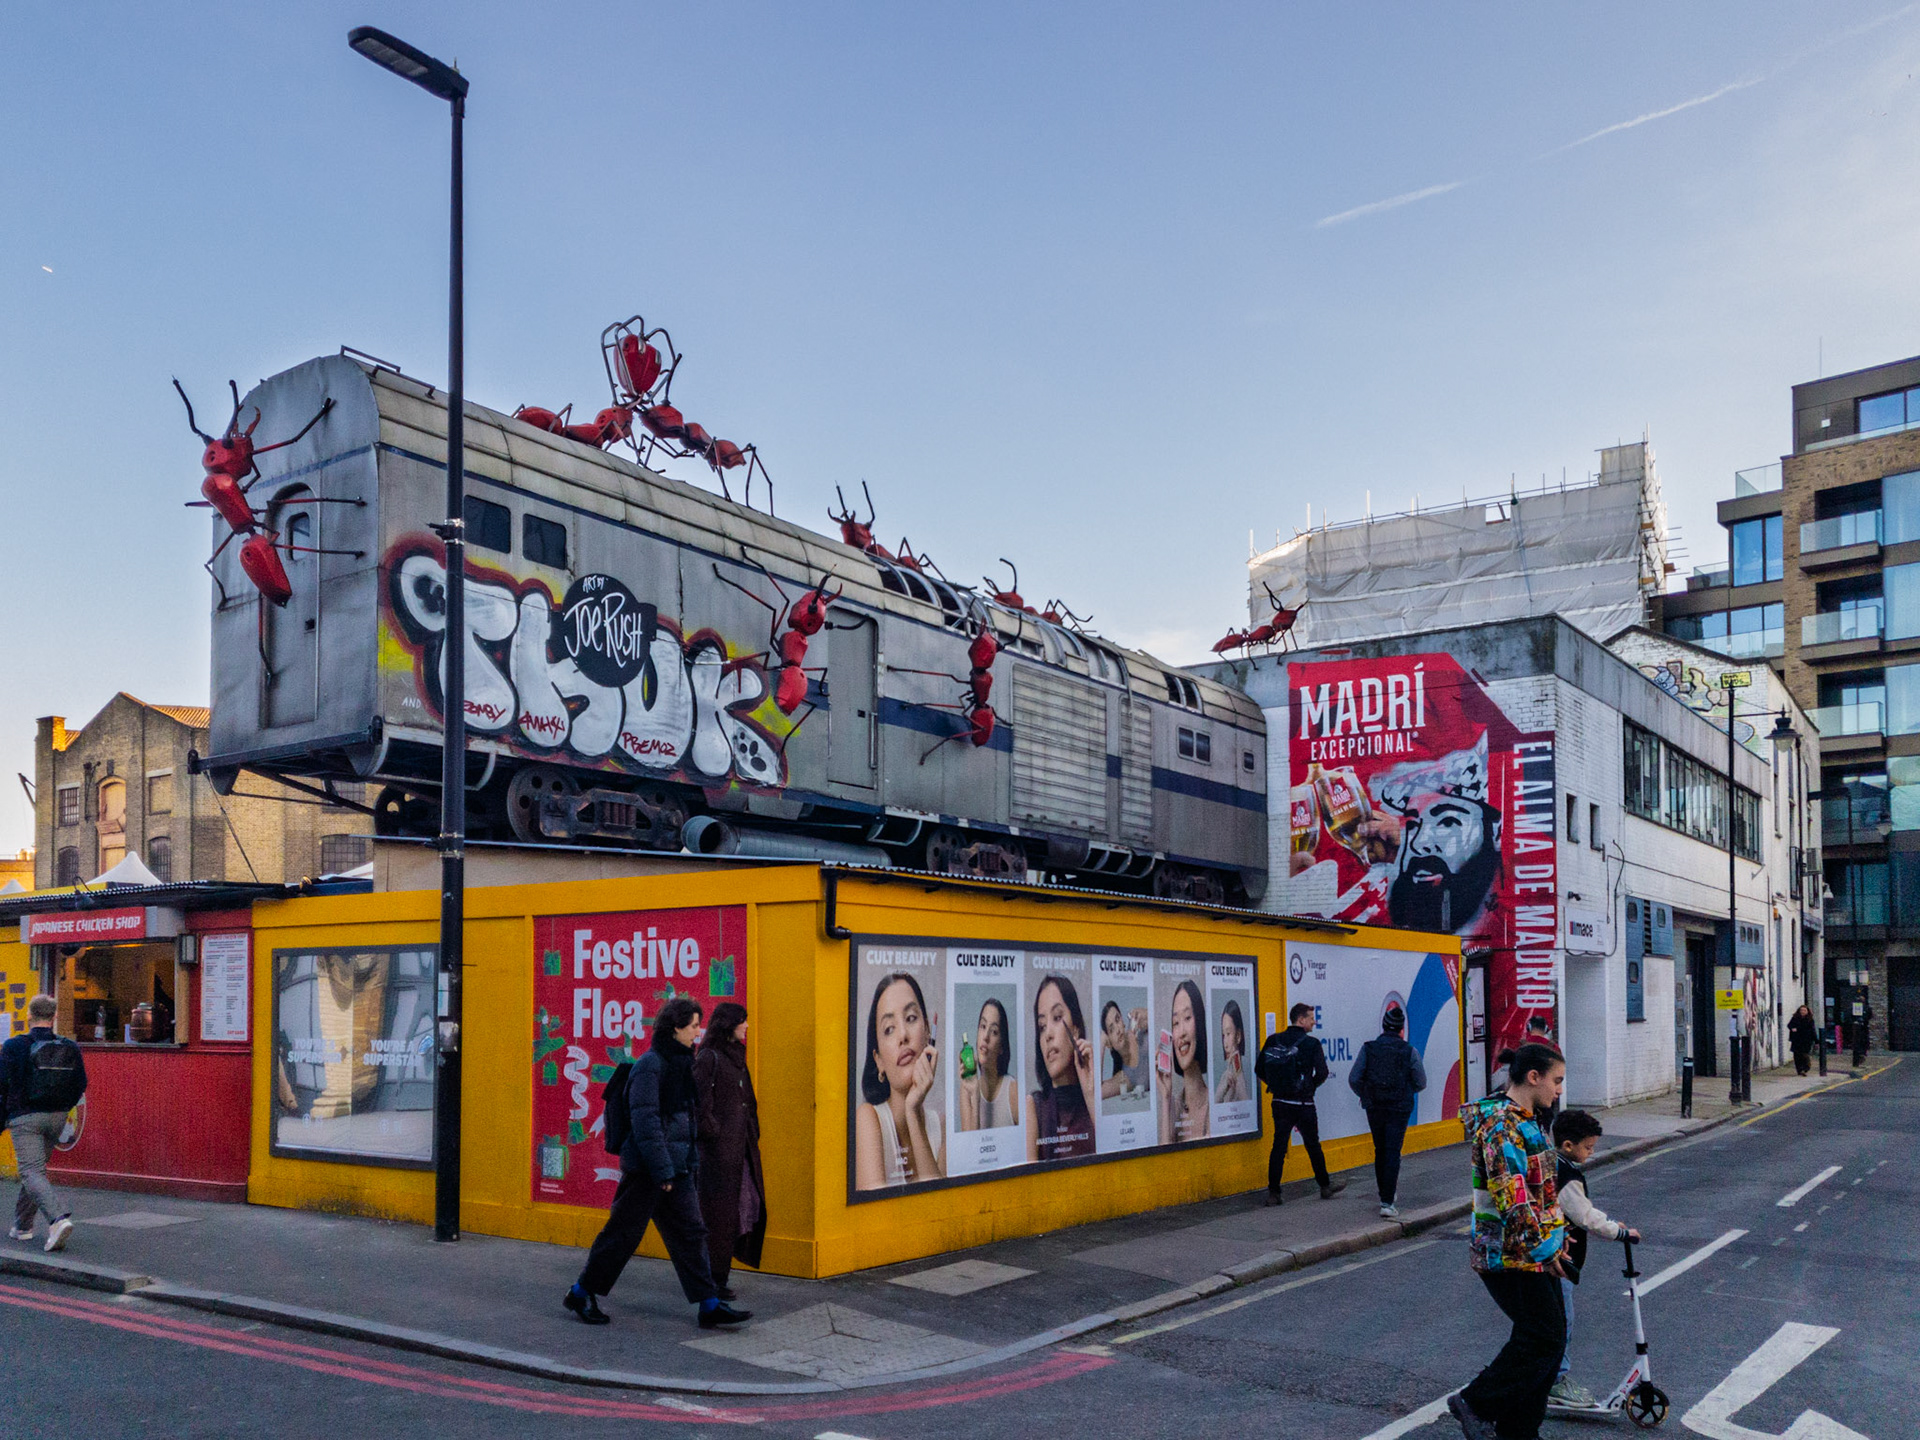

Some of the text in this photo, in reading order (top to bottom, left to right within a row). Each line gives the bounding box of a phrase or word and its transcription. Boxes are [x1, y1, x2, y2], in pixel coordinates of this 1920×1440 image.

[582, 574, 597, 593] ART
[601, 592, 643, 668] RUSH
[402, 697, 421, 709] AND
[1300, 662, 1426, 740] MADRÍ
[1311, 732, 1414, 760] EXCEPCIONAL
[1513, 741, 1555, 1009] EL ALMA DE MADRID
[30, 916, 141, 937] JAPANESE CHICKEN SHOP
[573, 927, 700, 979] Festive
[866, 950, 937, 966] CULT BEAUTY
[956, 953, 1015, 968] CULT BEAUTY
[1032, 956, 1086, 971] CULT BEAUTY
[1099, 959, 1146, 973] CULT BEAUTY
[1159, 962, 1201, 976] CULT BEAUTY
[1211, 965, 1248, 978] CULT BEAUTY
[1307, 959, 1327, 970] Vinegar
[573, 988, 645, 1040] Flea
[370, 1040, 405, 1052] YOU'RE
